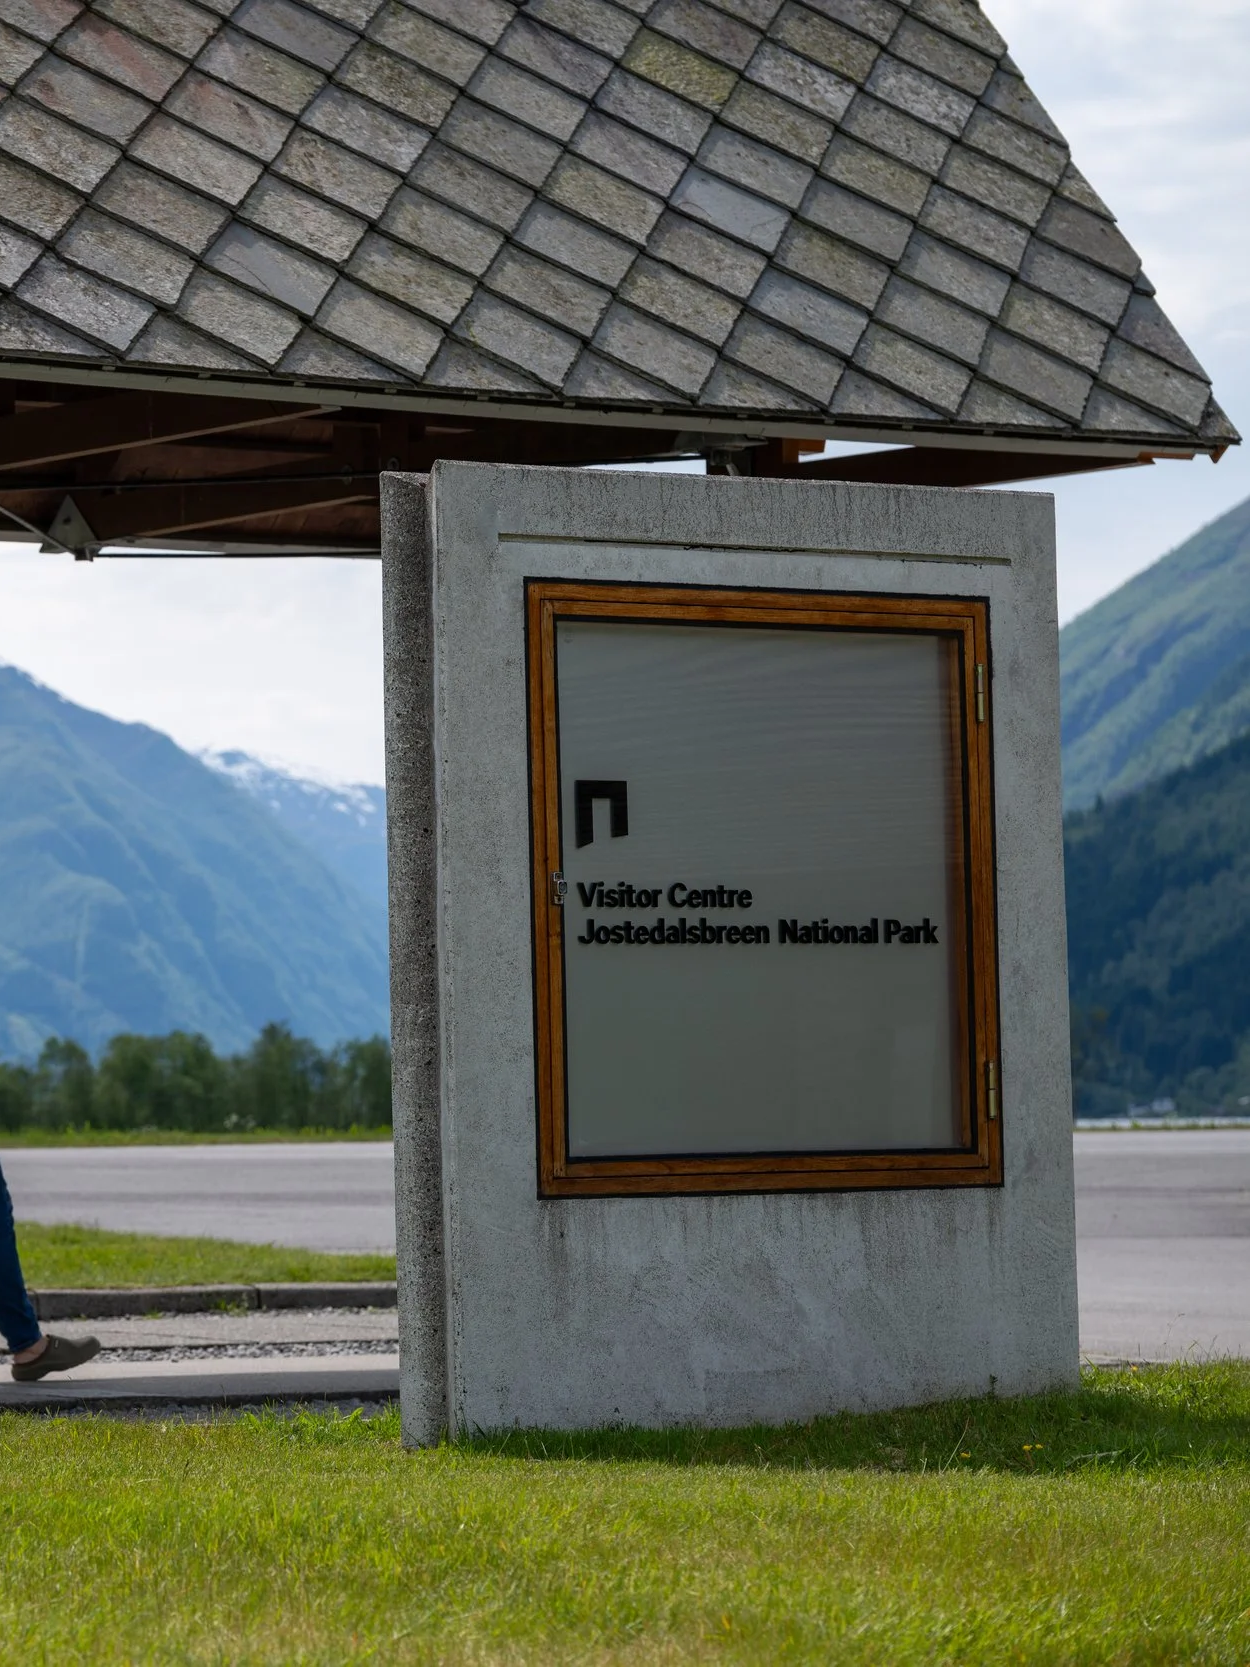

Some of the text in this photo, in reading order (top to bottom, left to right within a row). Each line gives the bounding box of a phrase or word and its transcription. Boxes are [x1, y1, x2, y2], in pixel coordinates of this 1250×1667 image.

[577, 881, 753, 908] Visitor Centre
[578, 918, 939, 945] Jostedalsbreen National Park
